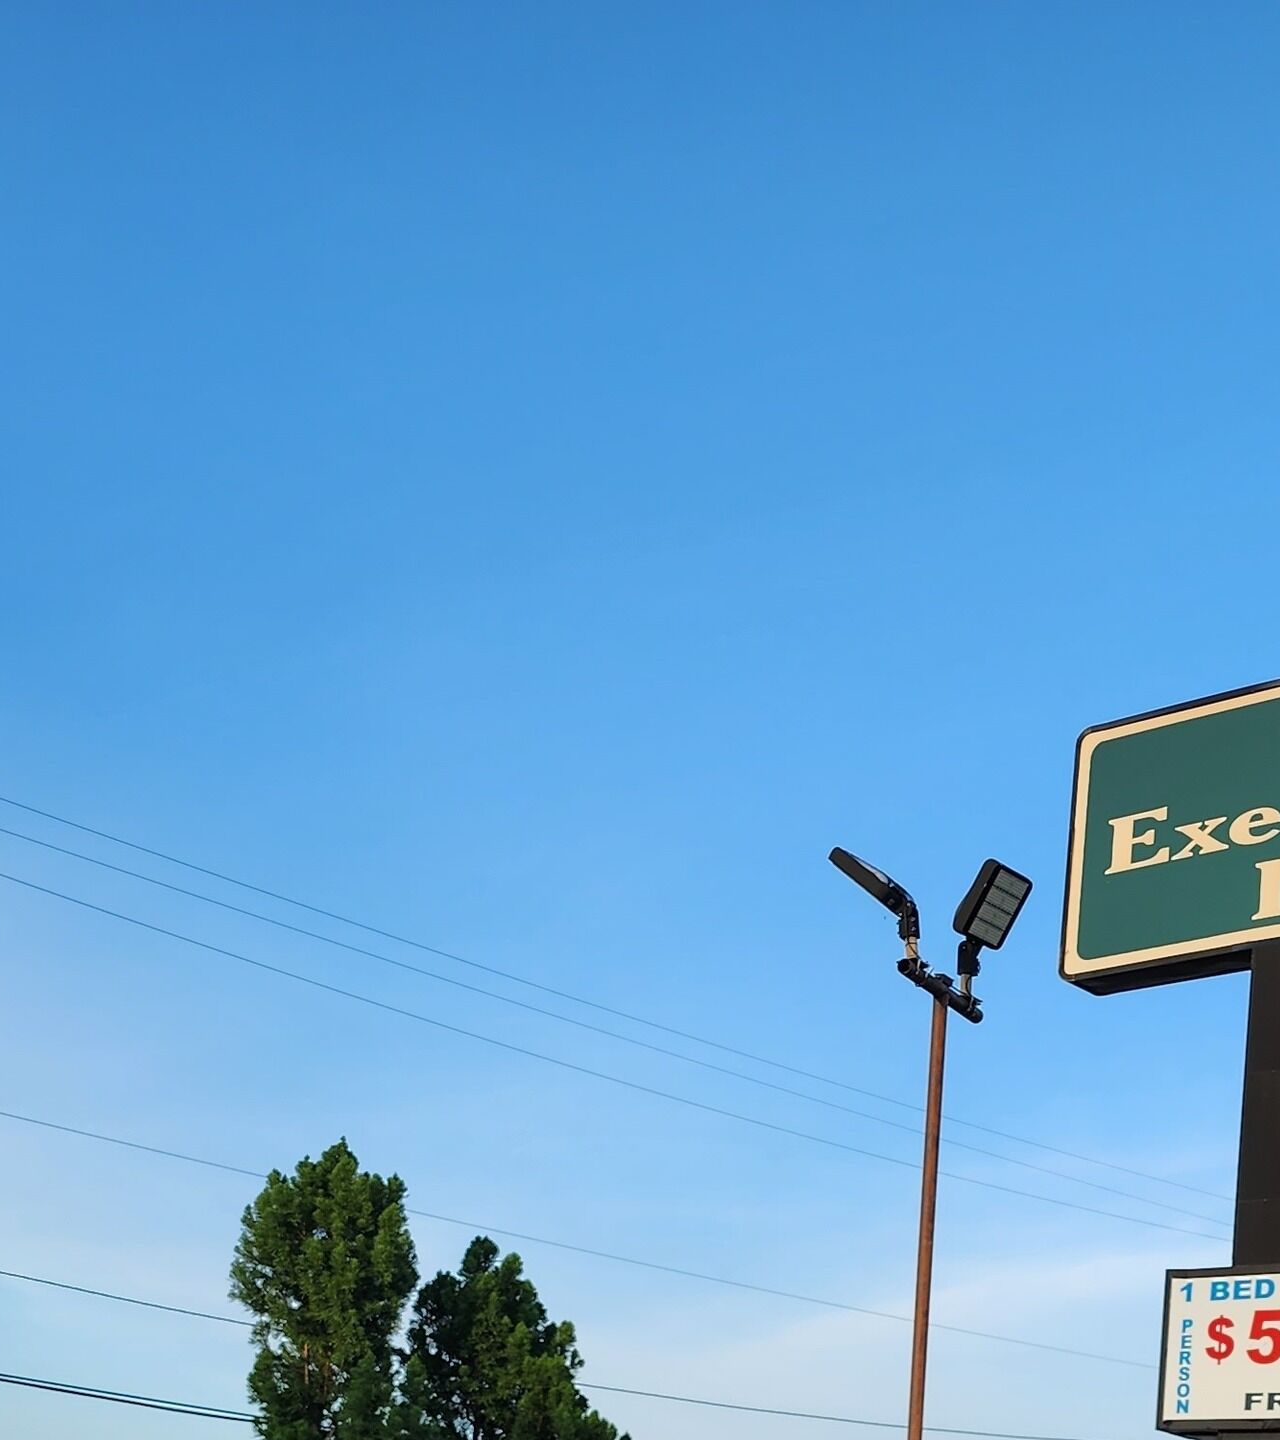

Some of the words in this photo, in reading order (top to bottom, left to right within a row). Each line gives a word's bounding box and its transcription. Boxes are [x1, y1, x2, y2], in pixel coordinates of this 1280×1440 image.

[1179, 1282, 1194, 1302] 1
[1209, 1278, 1276, 1301] BED
[1176, 1318, 1194, 1415] PERSON
